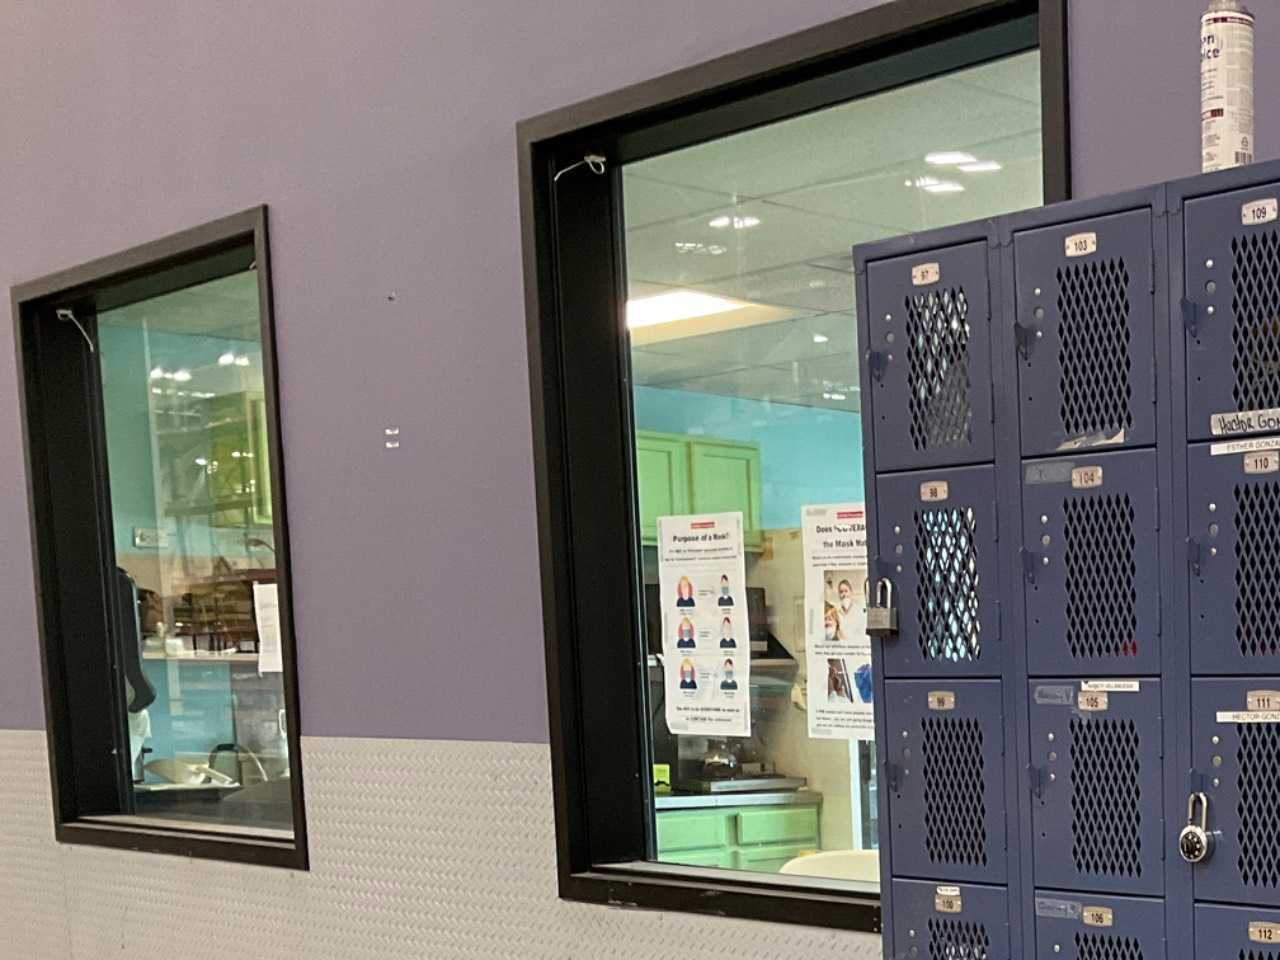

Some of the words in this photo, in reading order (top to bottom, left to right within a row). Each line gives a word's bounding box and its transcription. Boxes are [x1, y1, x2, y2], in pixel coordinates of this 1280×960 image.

[1252, 207, 1266, 219] 109
[1074, 240, 1087, 251] 103
[1227, 441, 1253, 451] ESTHER
[1254, 458, 1269, 469] 110
[1079, 472, 1094, 483] 104
[1086, 697, 1098, 707] 105
[1257, 698, 1270, 708] 111
[1232, 713, 1260, 721] HECTOR
[1259, 929, 1272, 940] 112
